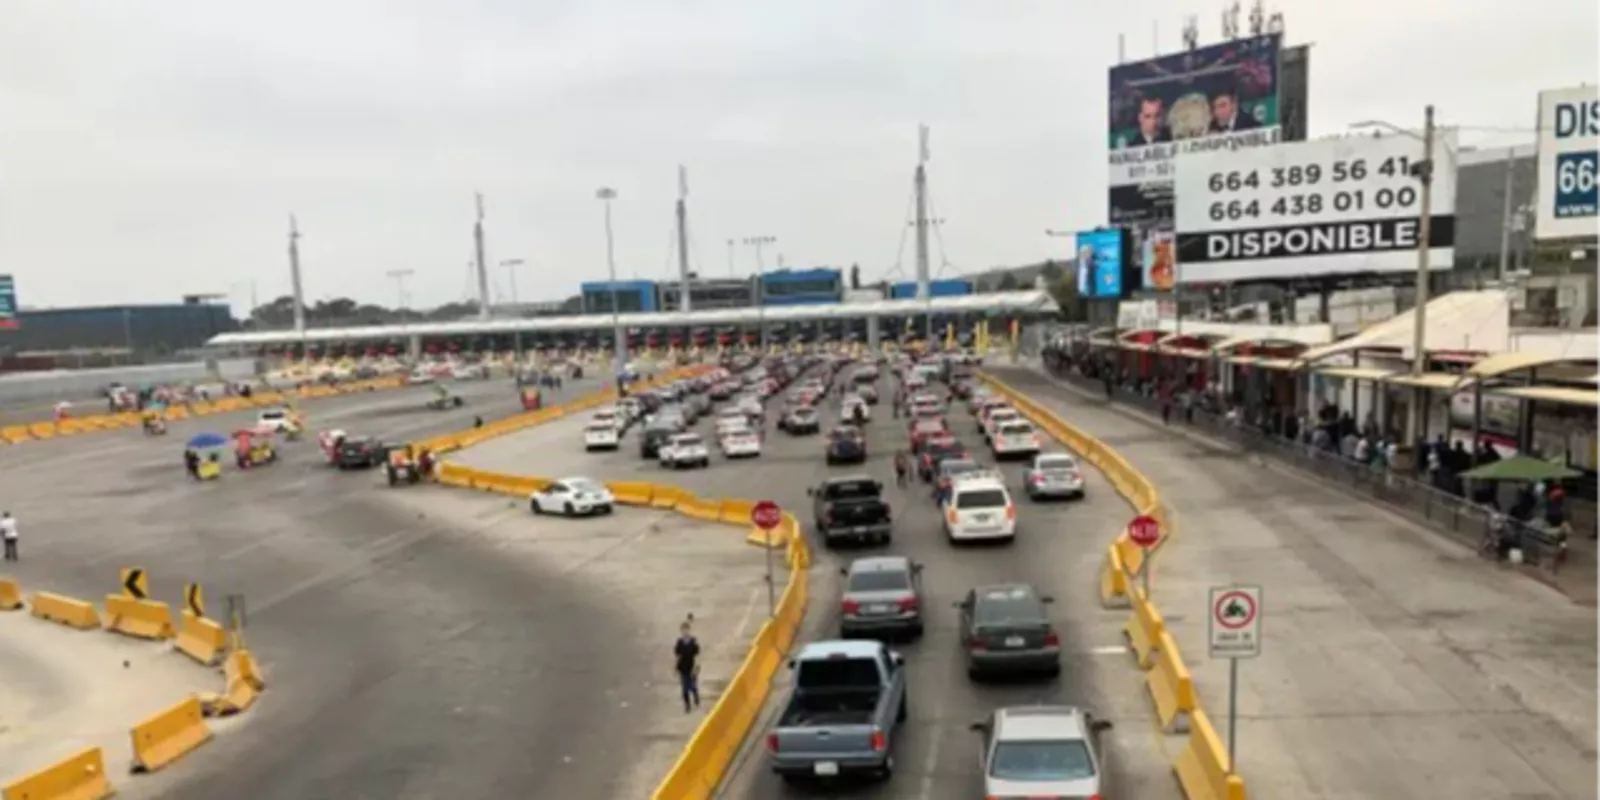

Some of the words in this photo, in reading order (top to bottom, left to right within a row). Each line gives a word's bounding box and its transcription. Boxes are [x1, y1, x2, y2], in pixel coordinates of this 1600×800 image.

[1208, 171, 1260, 194] 664
[1271, 164, 1322, 188] 389
[1332, 159, 1367, 183] 56
[1378, 156, 1409, 178] 41
[1208, 200, 1260, 222] 664
[1271, 193, 1323, 216] 438
[1333, 188, 1364, 212] 01
[1375, 185, 1417, 209] 00
[1207, 221, 1417, 259] DISPONIBLE
